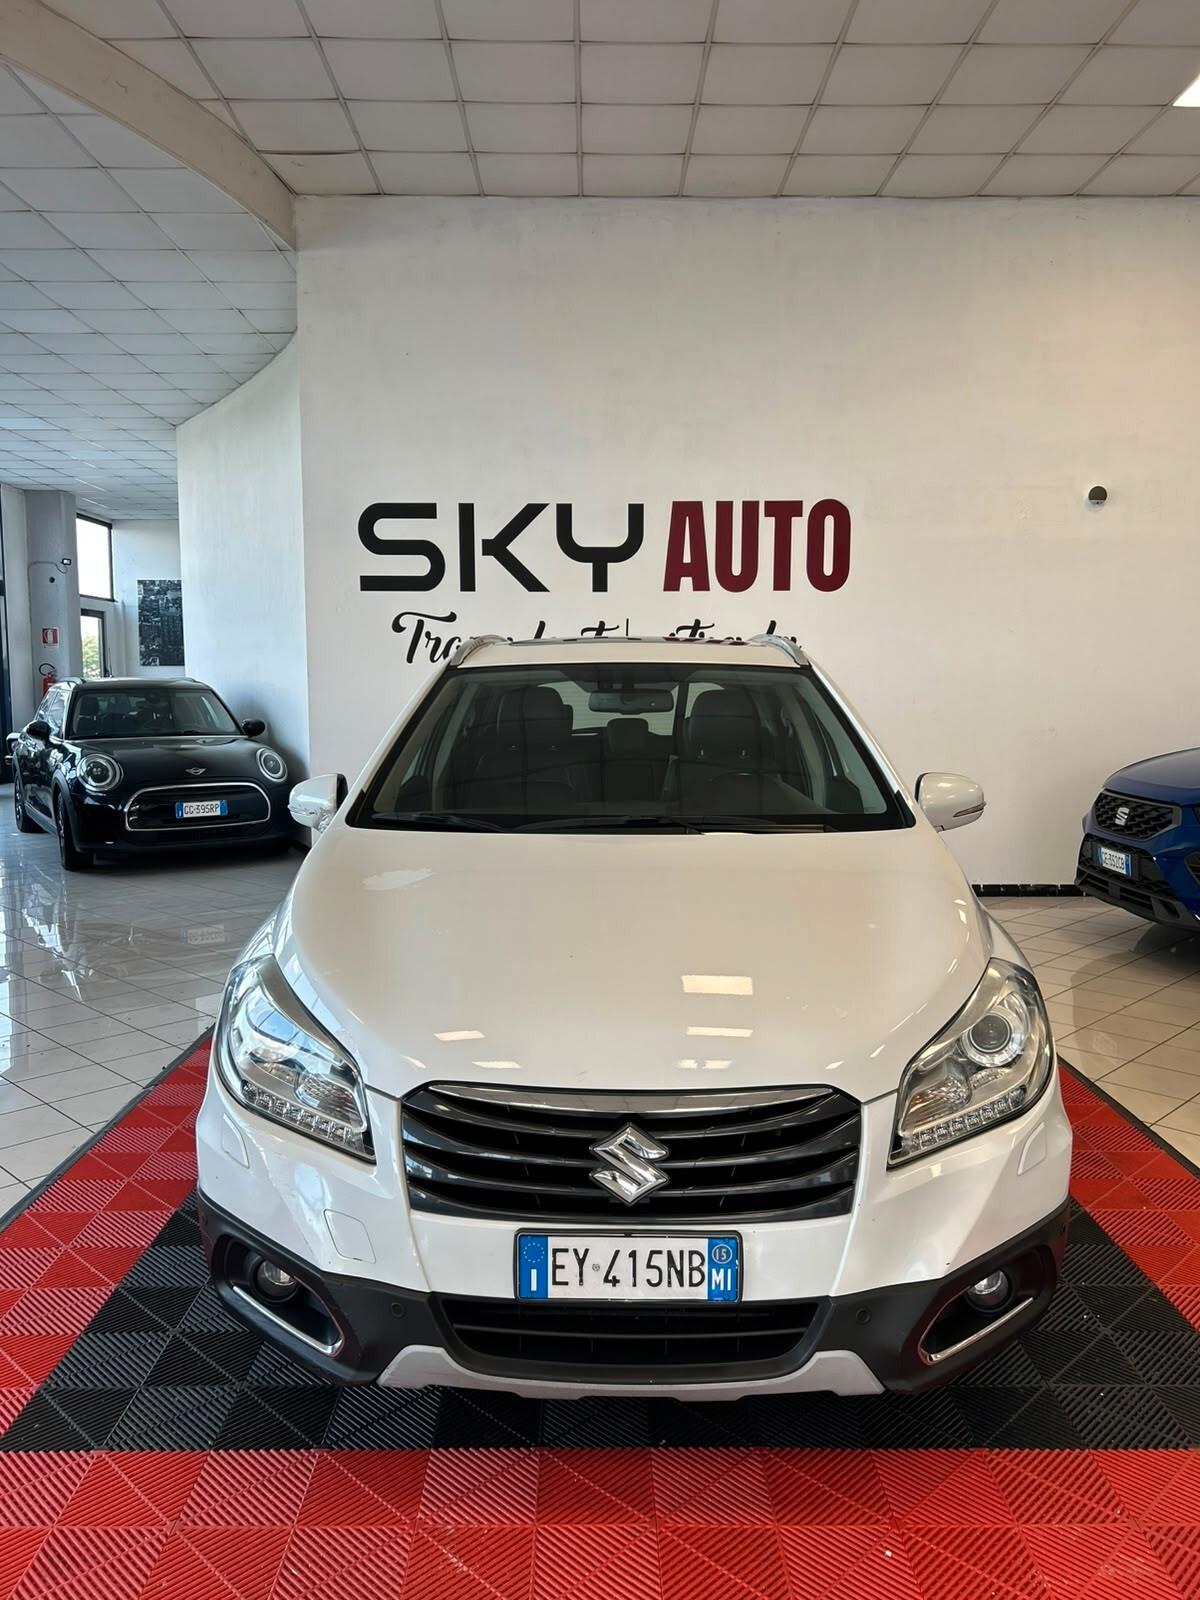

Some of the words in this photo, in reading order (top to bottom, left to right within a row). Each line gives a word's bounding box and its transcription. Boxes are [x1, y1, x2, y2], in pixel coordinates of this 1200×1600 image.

[357, 502, 645, 593] SKY
[662, 498, 852, 593] AUTO
[715, 1248, 727, 1261] 15
[551, 1247, 590, 1287] EY
[602, 1249, 706, 1288] 415NB
[711, 1268, 732, 1291] MI
[530, 1268, 537, 1292] I
